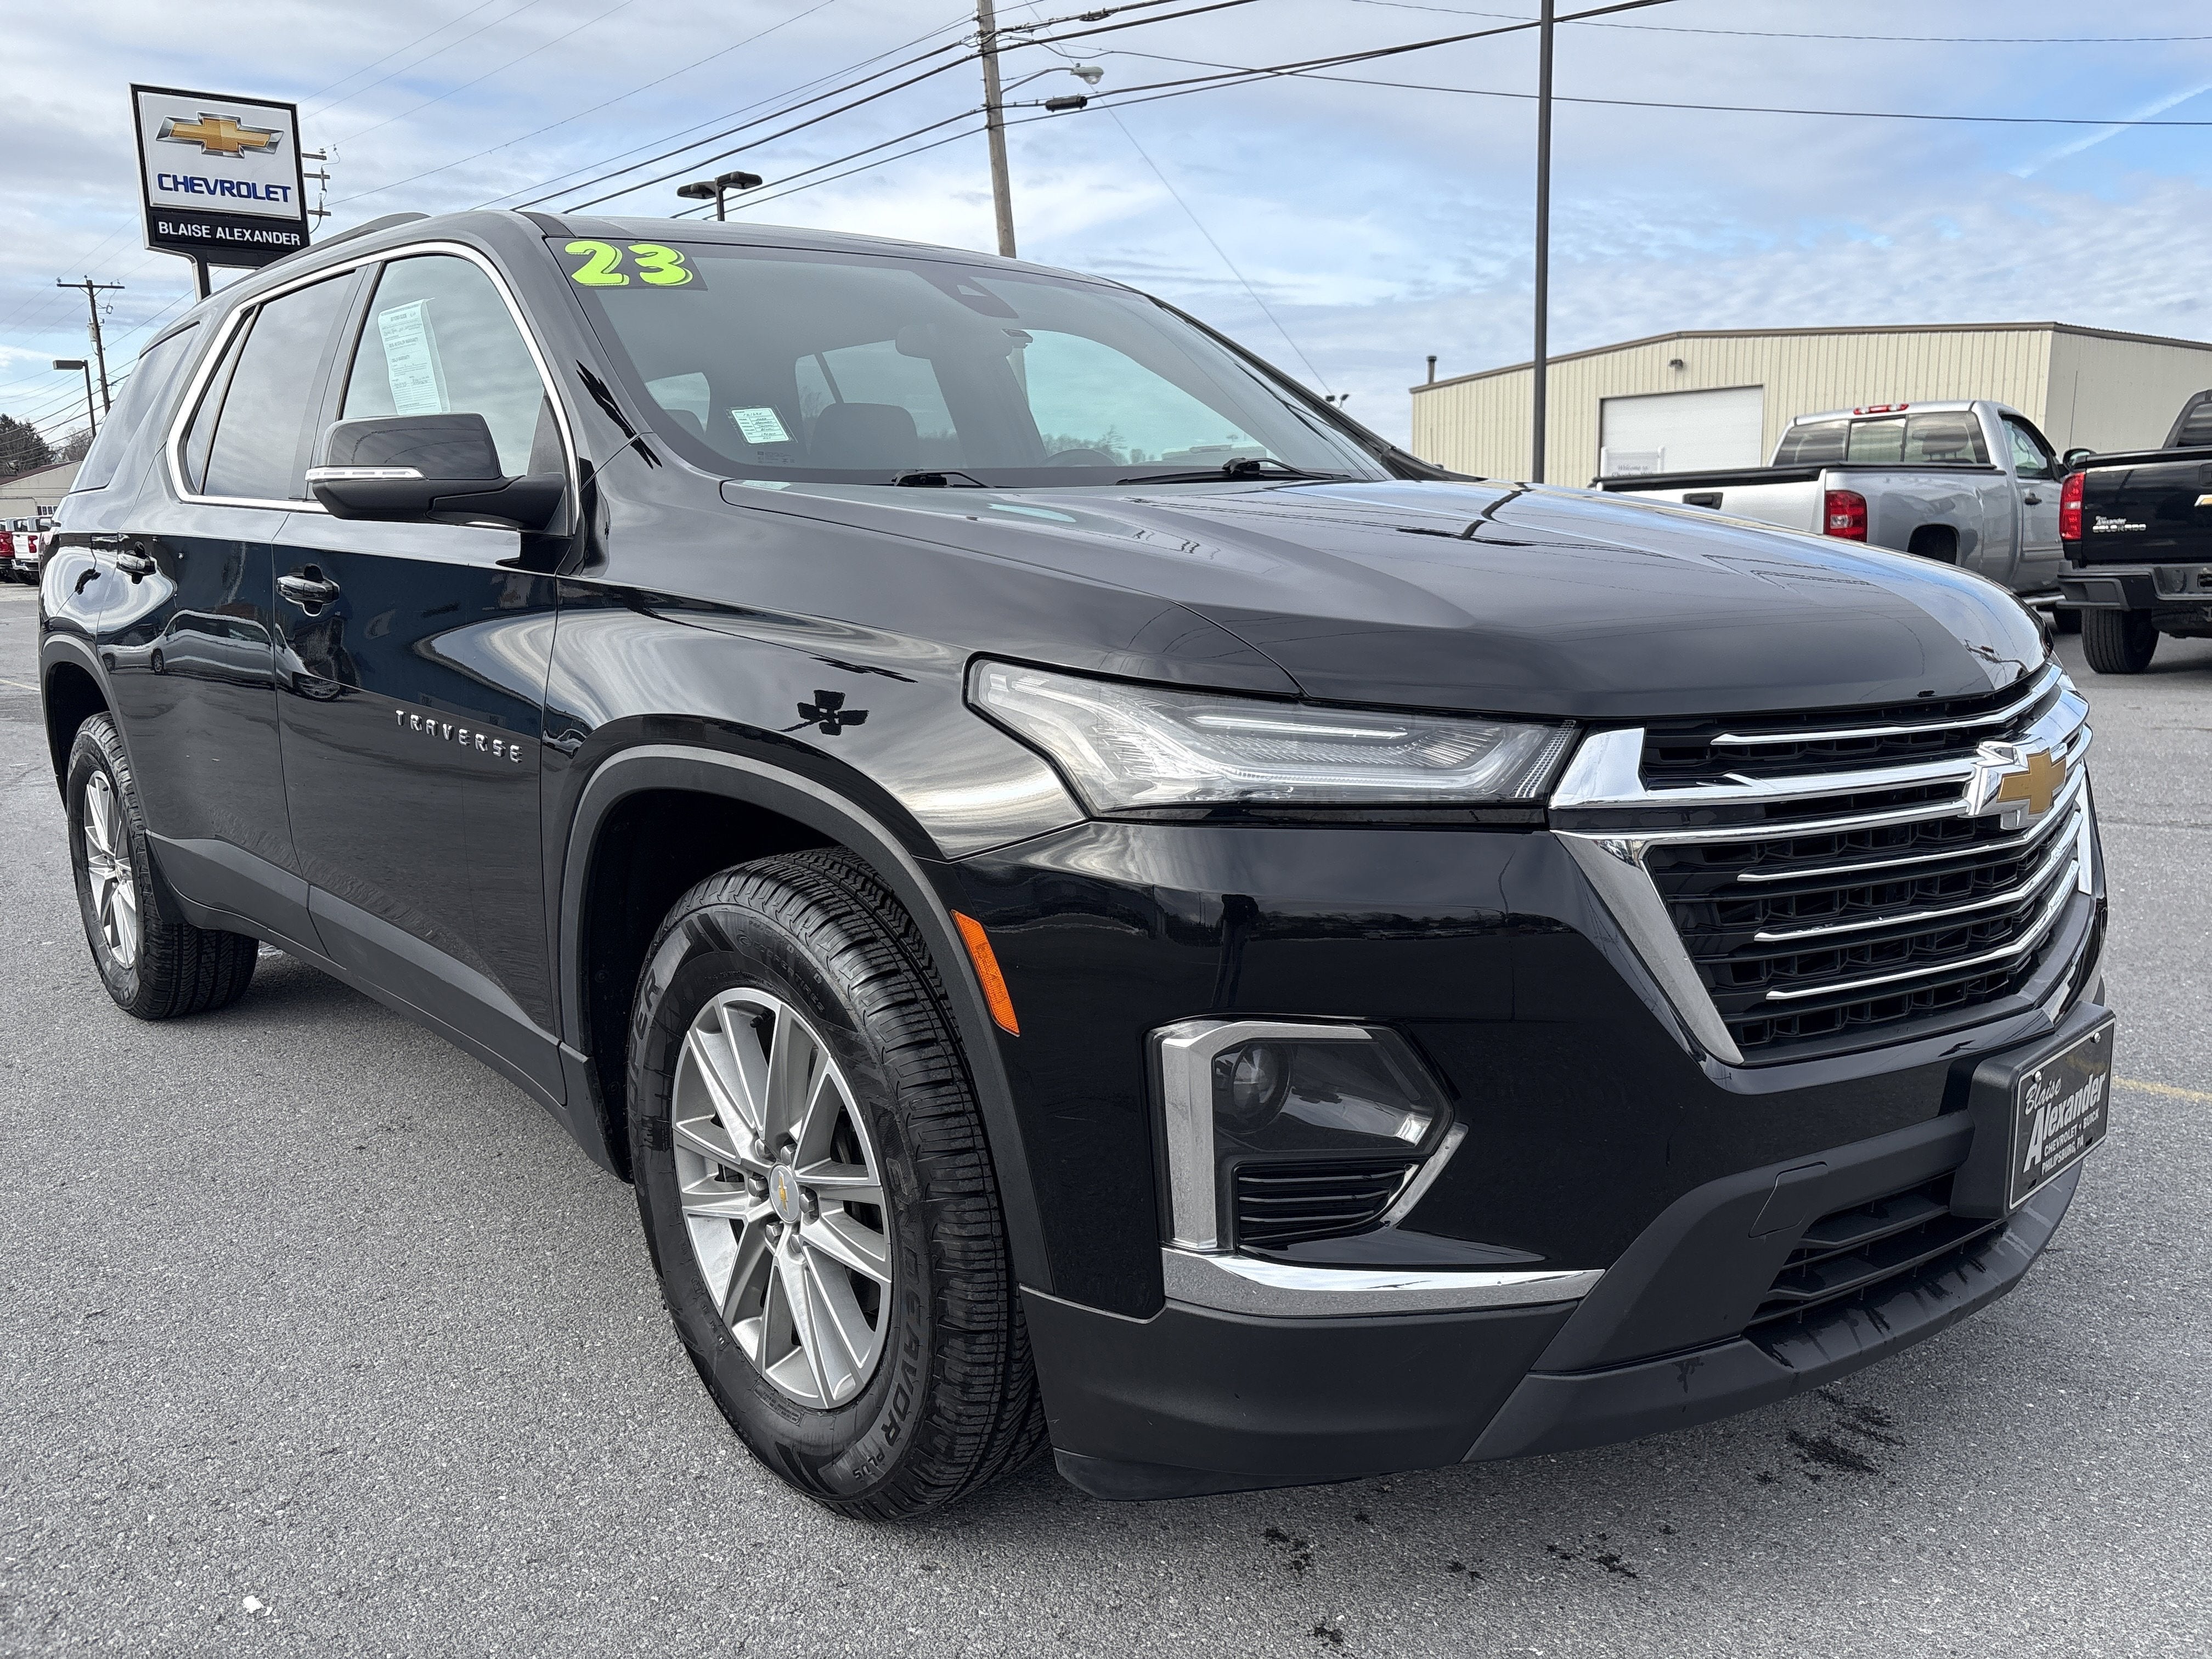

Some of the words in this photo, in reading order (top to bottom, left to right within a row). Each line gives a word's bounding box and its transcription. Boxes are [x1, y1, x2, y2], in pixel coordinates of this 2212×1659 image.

[157, 173, 291, 202] CHEVROLET
[158, 221, 212, 238] BLAISE
[216, 226, 301, 246] ALEXANDER
[565, 240, 693, 286] 23
[2093, 524, 2146, 533] COLORADO
[396, 710, 523, 763] TRAVERSE
[2025, 1077, 2062, 1115] Blaise
[2023, 1071, 2106, 1173] Alexander
[2044, 1124, 2078, 1157] CHEVROLET
[2083, 1108, 2100, 1129] BUICK
[2076, 1134, 2084, 1150] PA
[852, 1447, 885, 1480] PLUS
